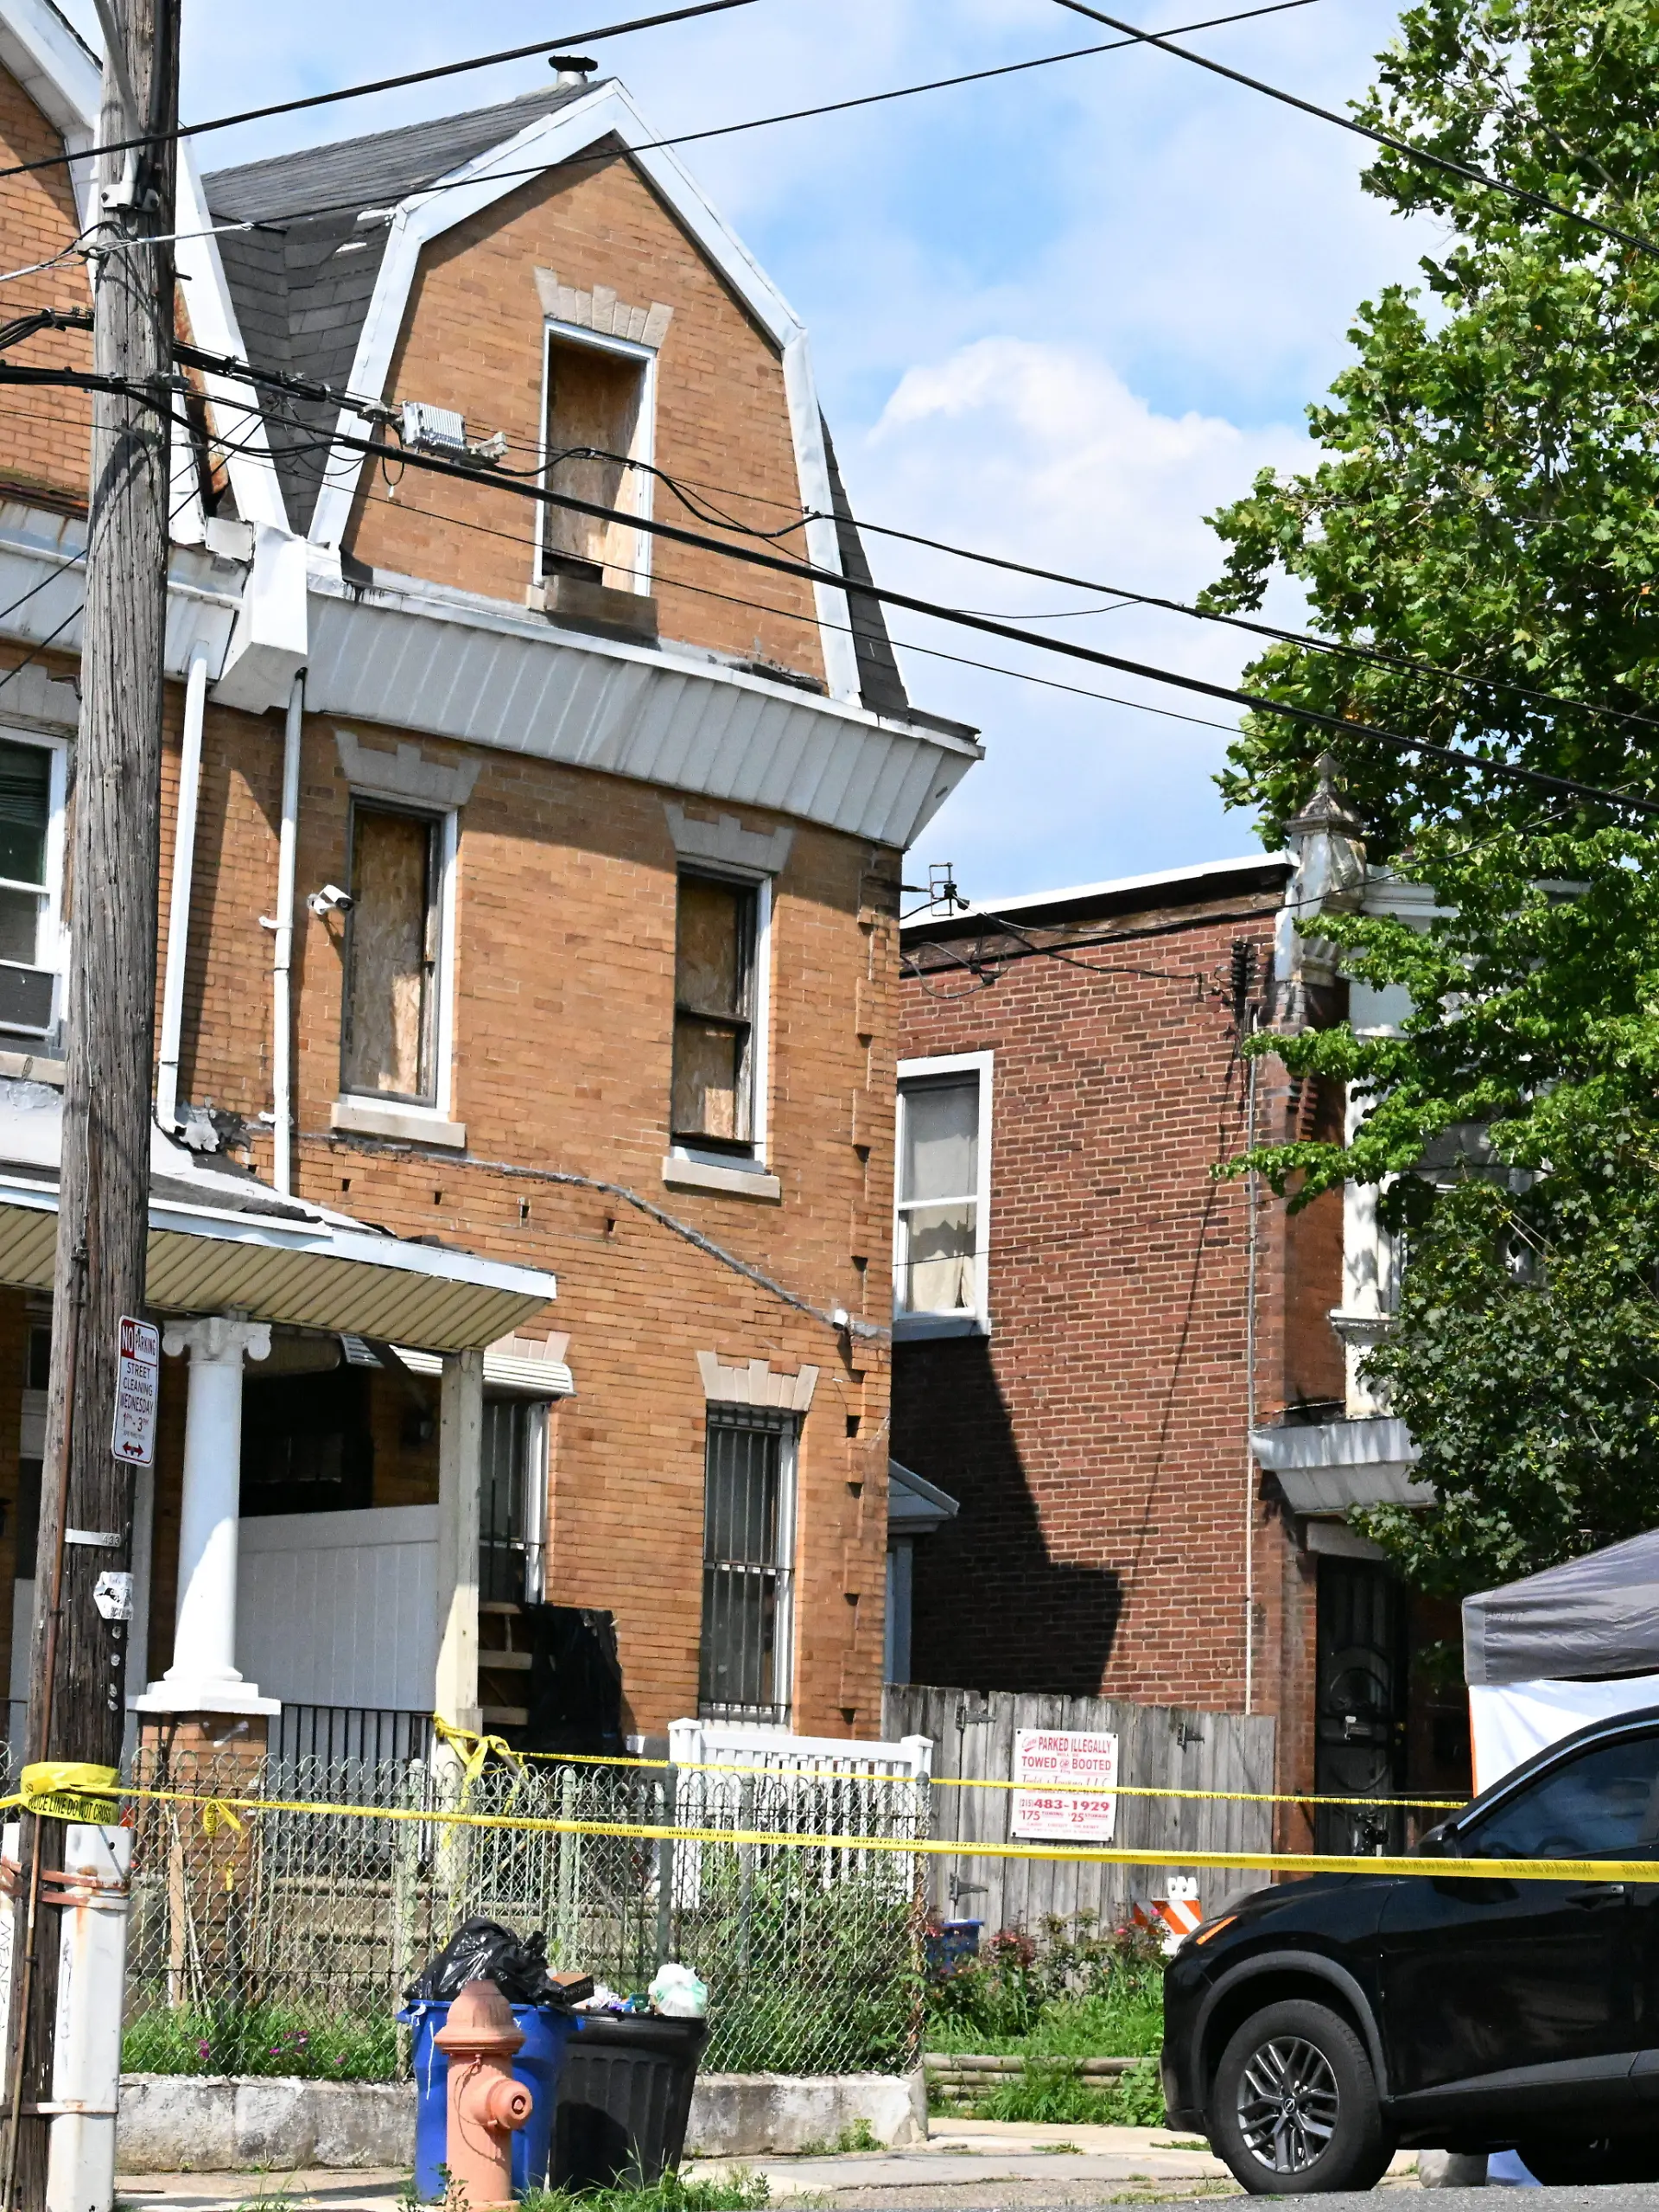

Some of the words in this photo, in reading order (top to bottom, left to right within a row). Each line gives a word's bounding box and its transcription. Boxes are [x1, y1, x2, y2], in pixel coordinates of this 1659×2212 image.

[122, 1325, 133, 1352] NO
[135, 1333, 156, 1357] PARKING
[127, 1362, 151, 1379] STREET
[123, 1377, 153, 1397] CLEANING
[120, 1392, 154, 1415] WEDNESDAY
[102, 1534, 120, 1546] 433
[1038, 1736, 1068, 1751] PARKED
[1071, 1738, 1111, 1753] ILLEGALLY
[1022, 1756, 1057, 1768] TOWED
[1072, 1758, 1111, 1770] BOOTED
[28, 1793, 48, 1812] POLICE
[49, 1796, 67, 1815] LINE
[67, 1798, 79, 1816] DO
[79, 1801, 93, 1819] NOT
[93, 1803, 112, 1823] CROSS
